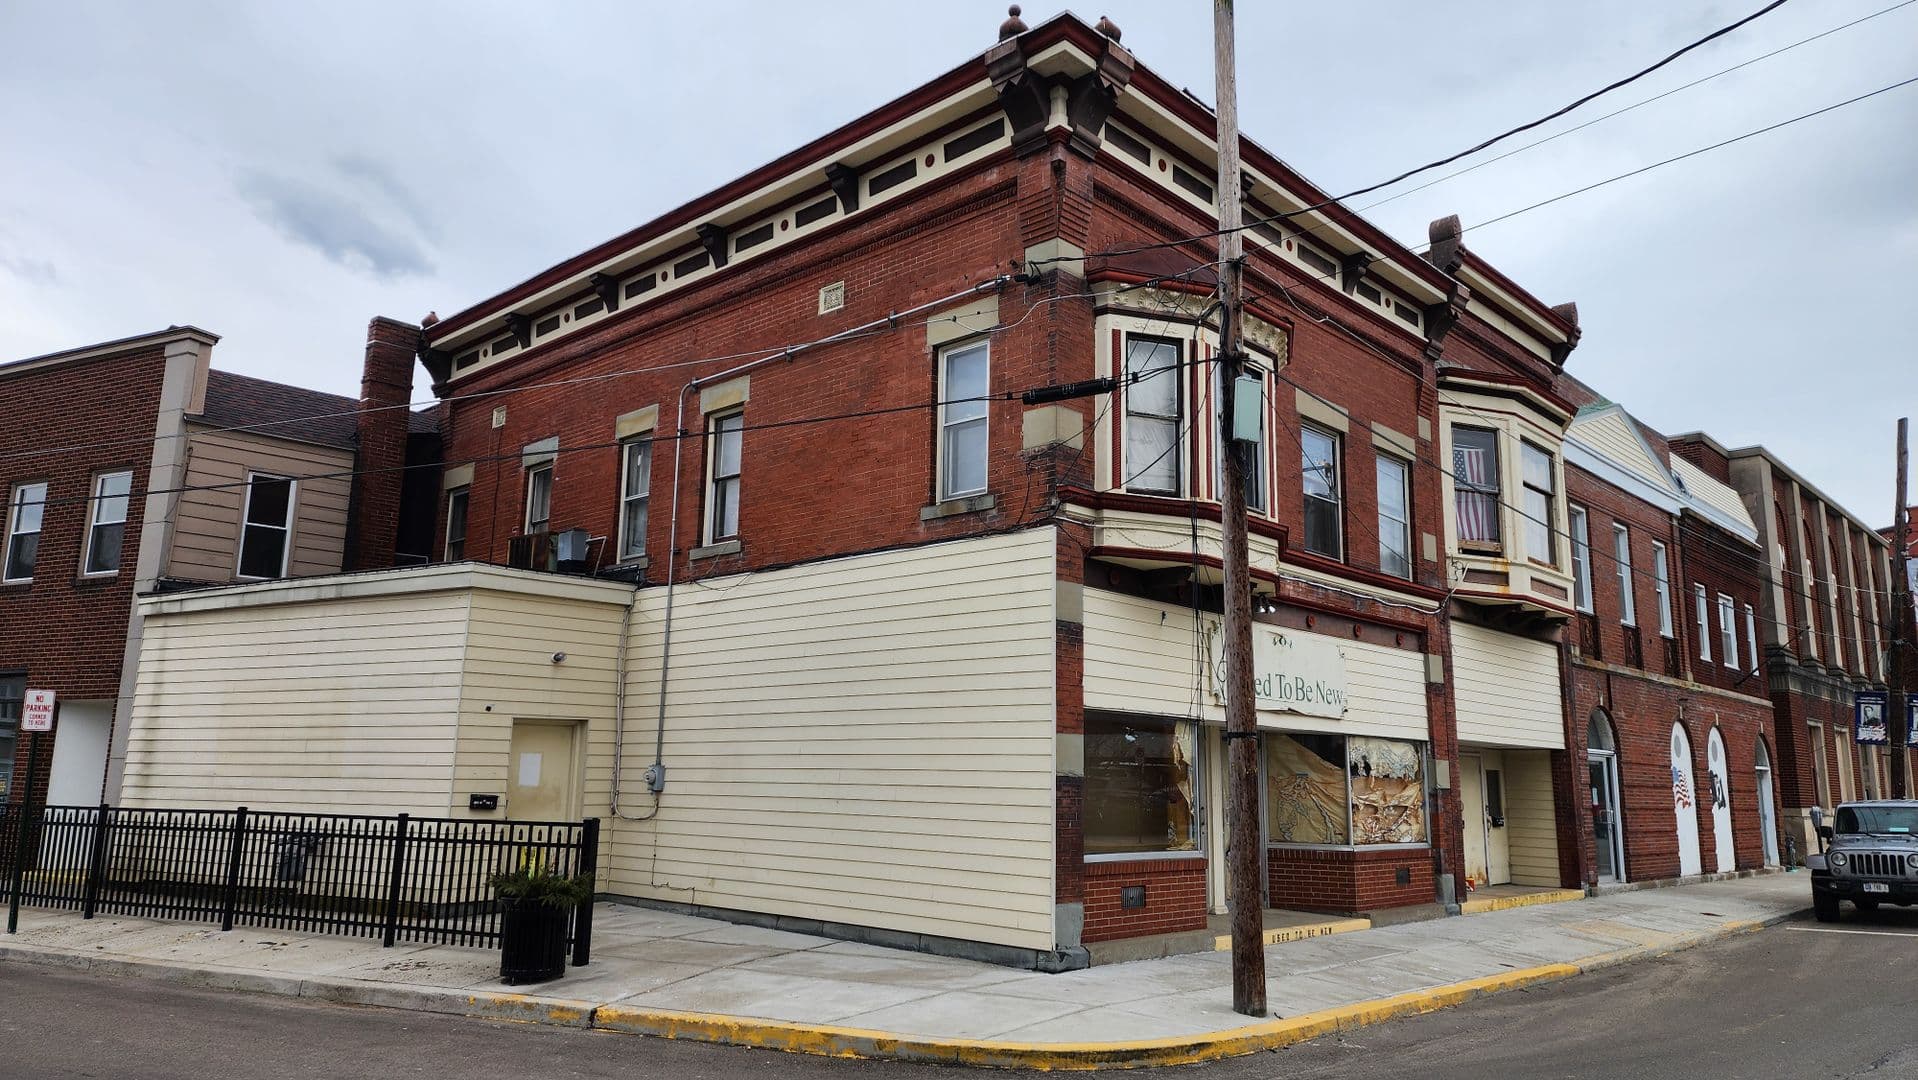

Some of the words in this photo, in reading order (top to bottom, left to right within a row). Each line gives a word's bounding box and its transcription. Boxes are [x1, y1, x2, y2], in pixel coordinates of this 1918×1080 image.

[1254, 673, 1272, 697] ed
[1275, 674, 1293, 699] To
[1295, 676, 1313, 702] Be
[1316, 680, 1344, 705] New
[26, 704, 52, 712] PARKING
[1271, 932, 1290, 943] USED
[1295, 930, 1303, 940] TO
[1320, 927, 1332, 936] NEW
